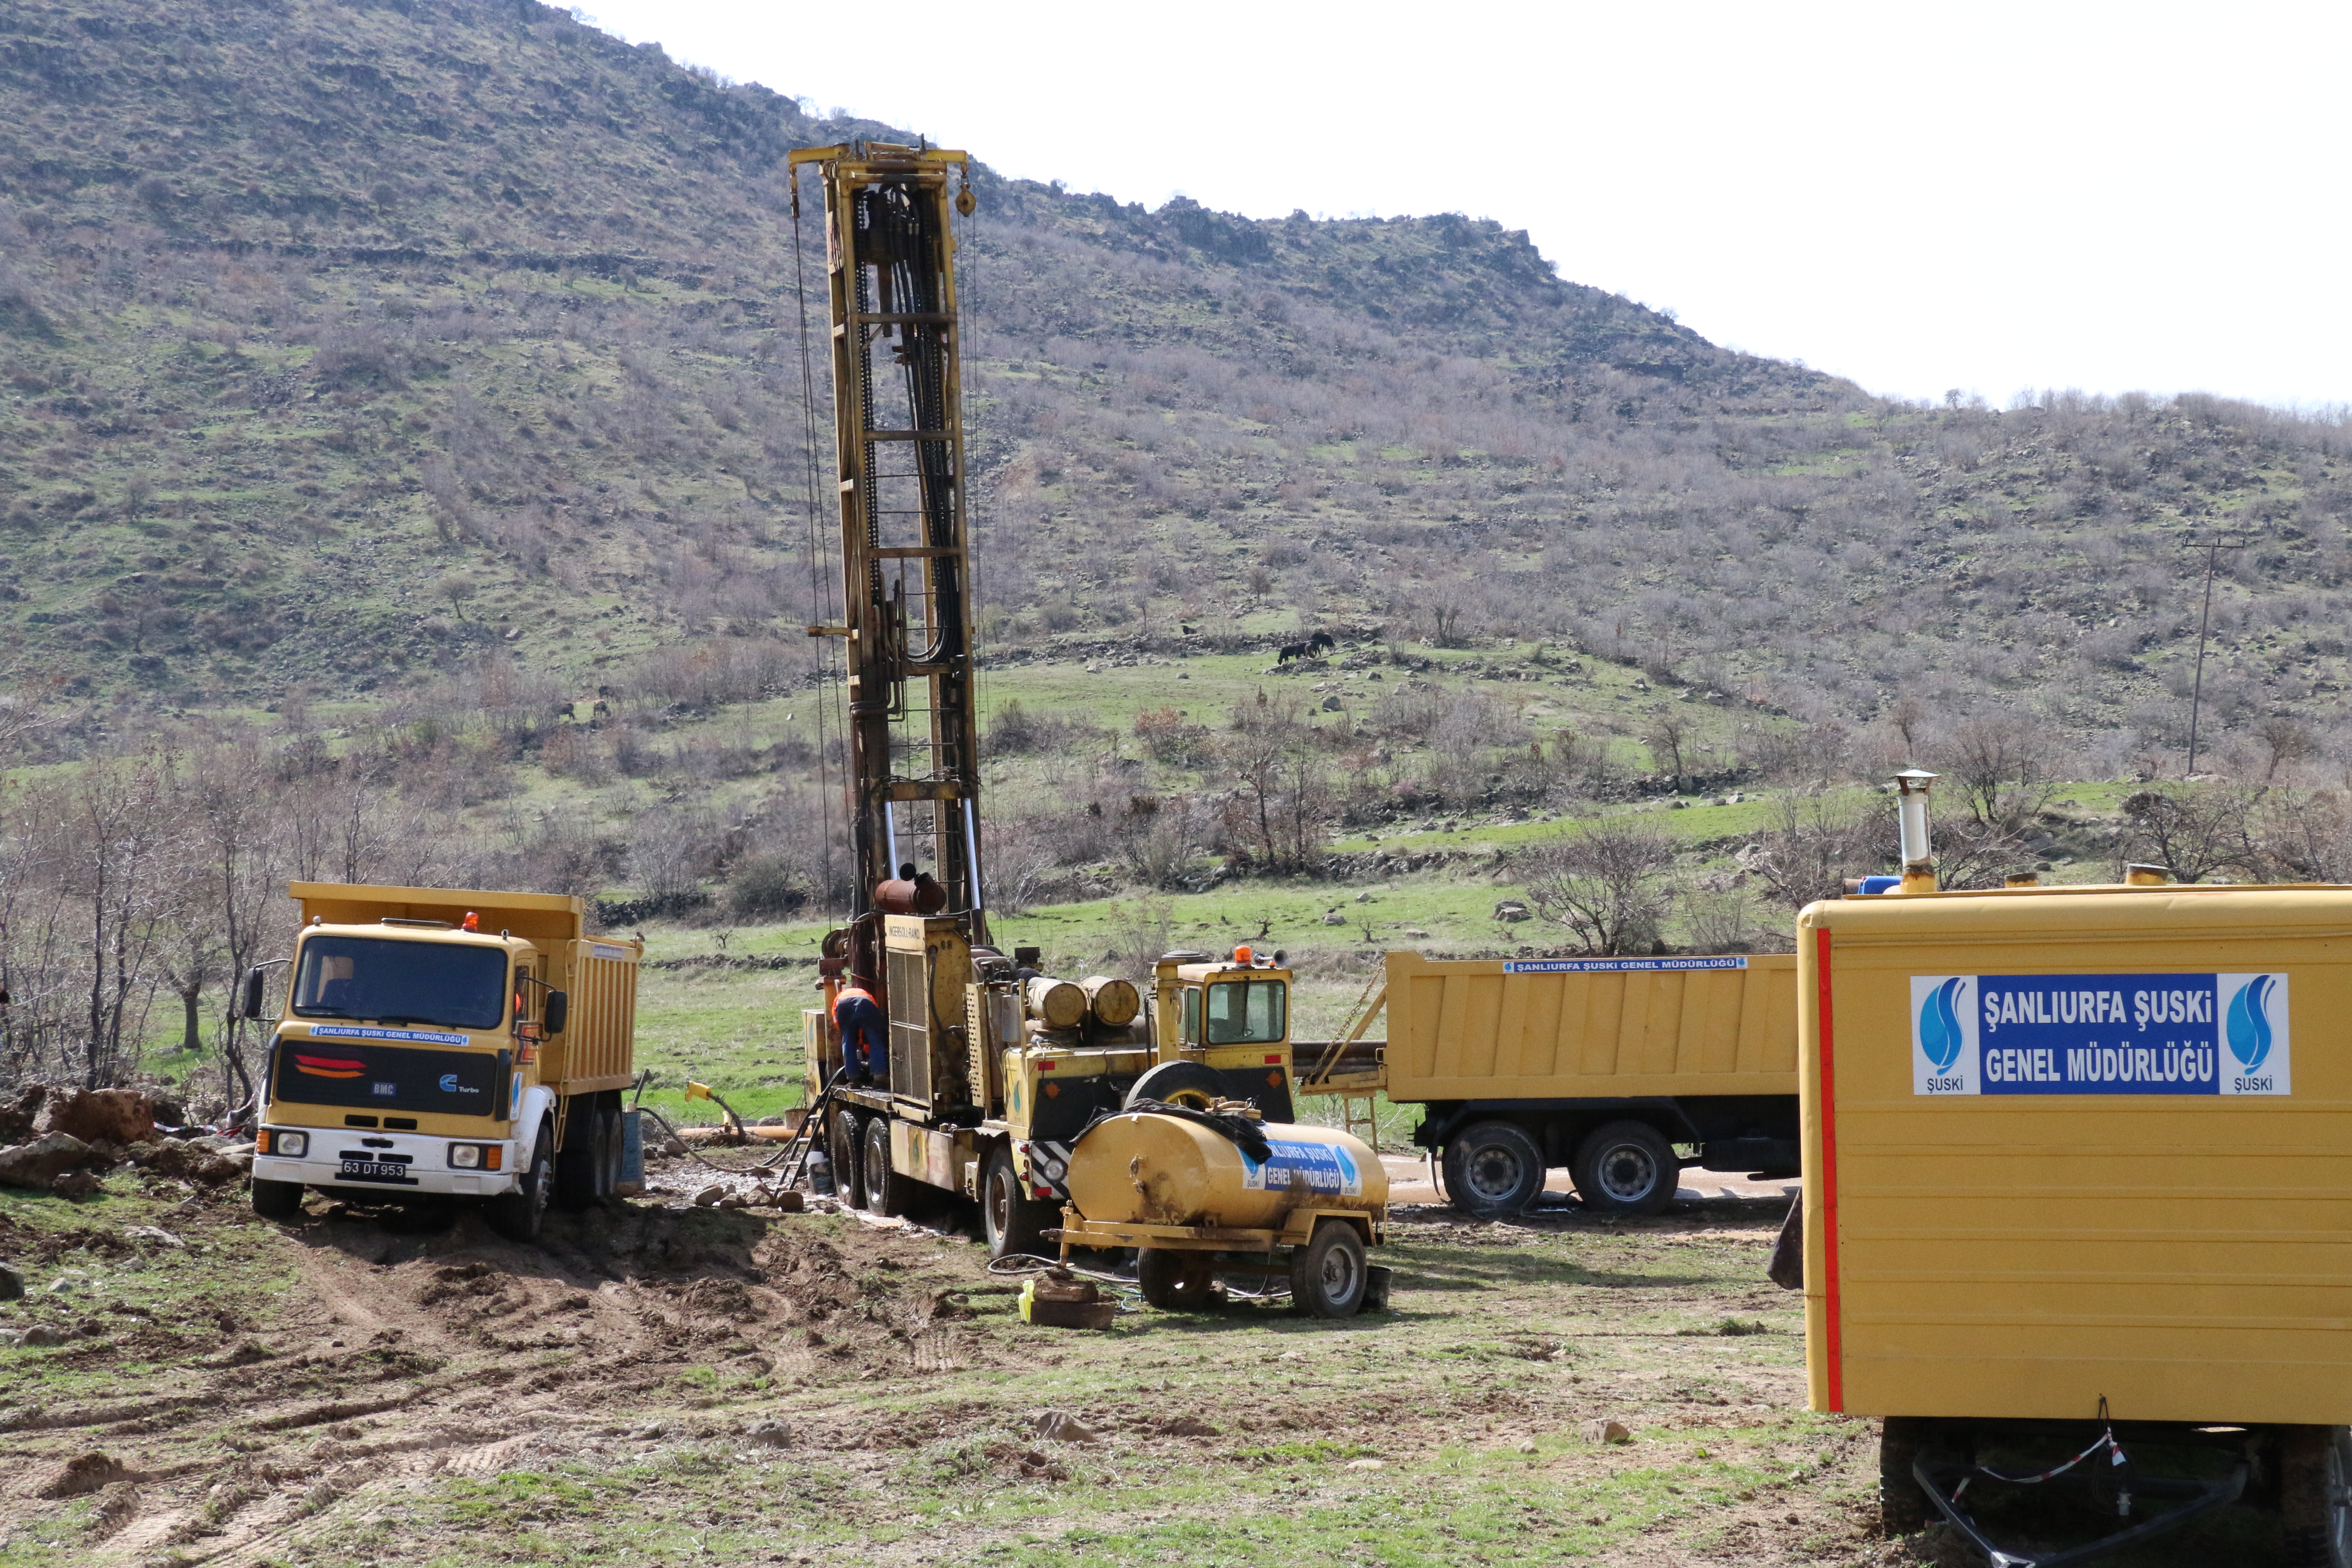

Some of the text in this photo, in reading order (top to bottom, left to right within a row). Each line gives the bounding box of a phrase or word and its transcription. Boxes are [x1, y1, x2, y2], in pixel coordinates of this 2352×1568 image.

[1517, 963, 1580, 972] ŞANLIURFA
[1662, 959, 1735, 968] MÜDÜRLÜĞÜ
[1984, 991, 2126, 1032] ŞANLIURFA
[319, 1027, 360, 1035] ŞANLIURFA
[1986, 1041, 2213, 1082] GENEL MÜDÜRLÜĞÜ
[374, 1084, 393, 1094] BMC
[1927, 1075, 1963, 1093] ŞUSKİ
[2235, 1074, 2272, 1093] ŞUSKİ
[1267, 1144, 1308, 1159] NLIURFA
[344, 1162, 404, 1176] 63 DT 953
[1268, 1167, 1291, 1185] GENEL
